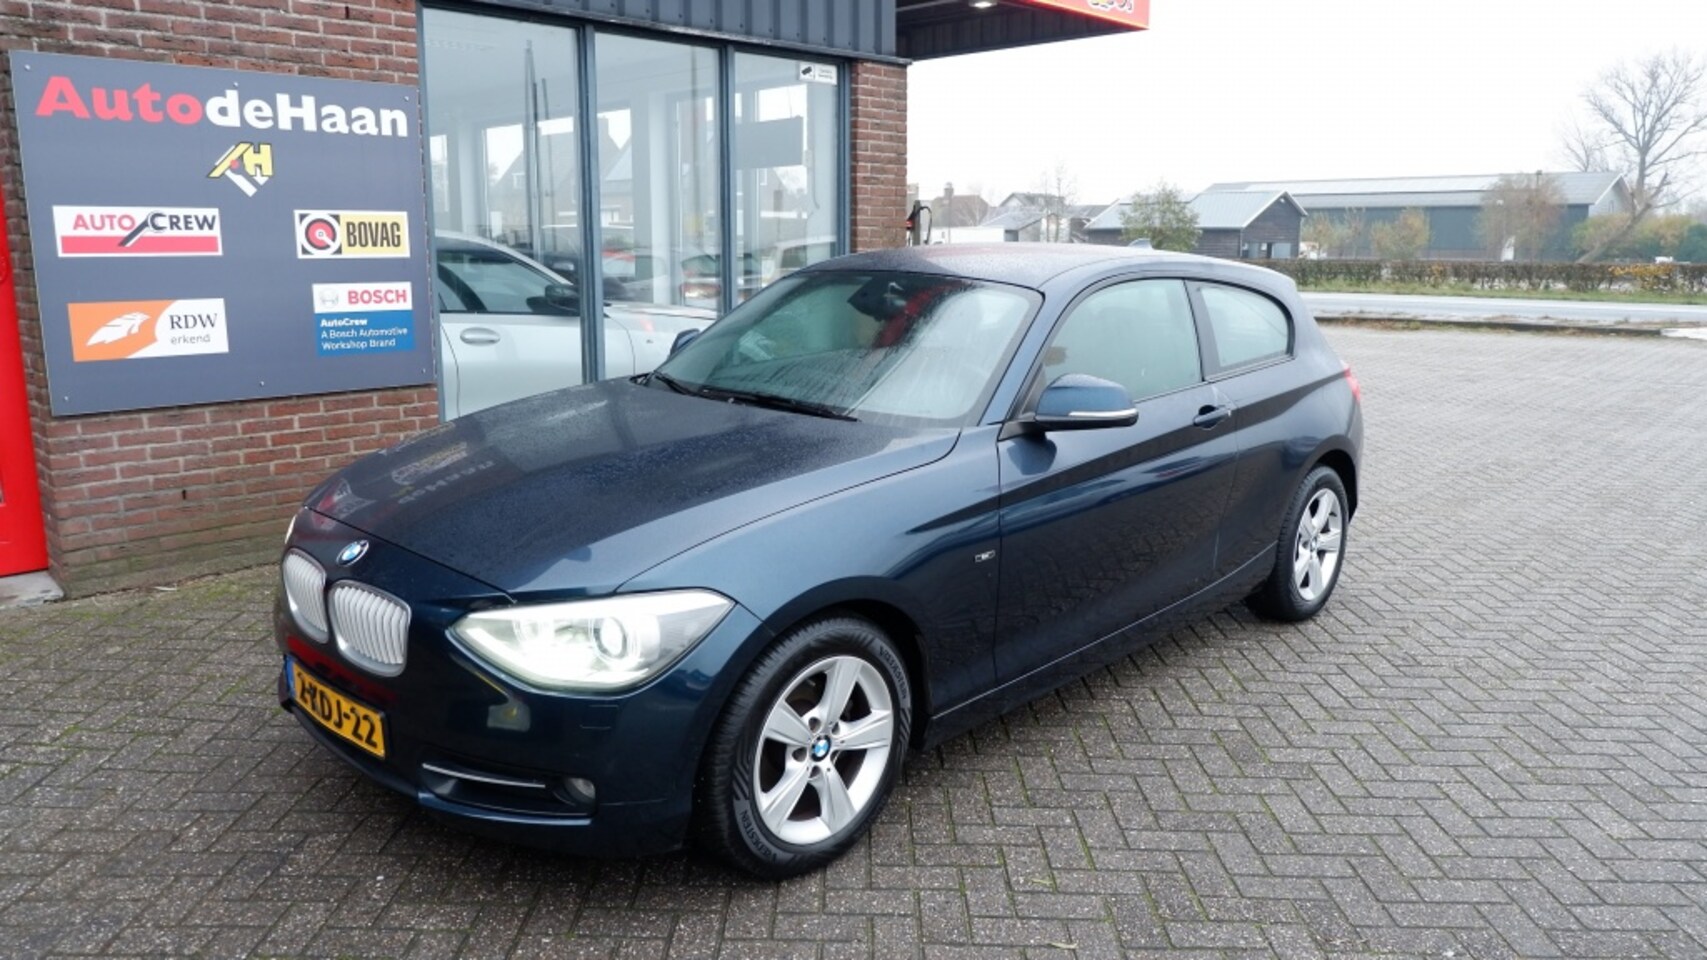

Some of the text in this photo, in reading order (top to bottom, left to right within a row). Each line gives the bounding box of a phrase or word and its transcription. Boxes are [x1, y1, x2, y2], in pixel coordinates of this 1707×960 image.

[73, 212, 216, 231] AUTO CREW
[346, 221, 401, 248] BOVAG
[347, 289, 407, 305] BOSCH
[169, 312, 218, 329] RDW
[320, 317, 368, 328] AutoCrew
[170, 333, 211, 345] erkend
[321, 326, 408, 339] A Bosch Automotive
[321, 338, 396, 350] Workshop Brand
